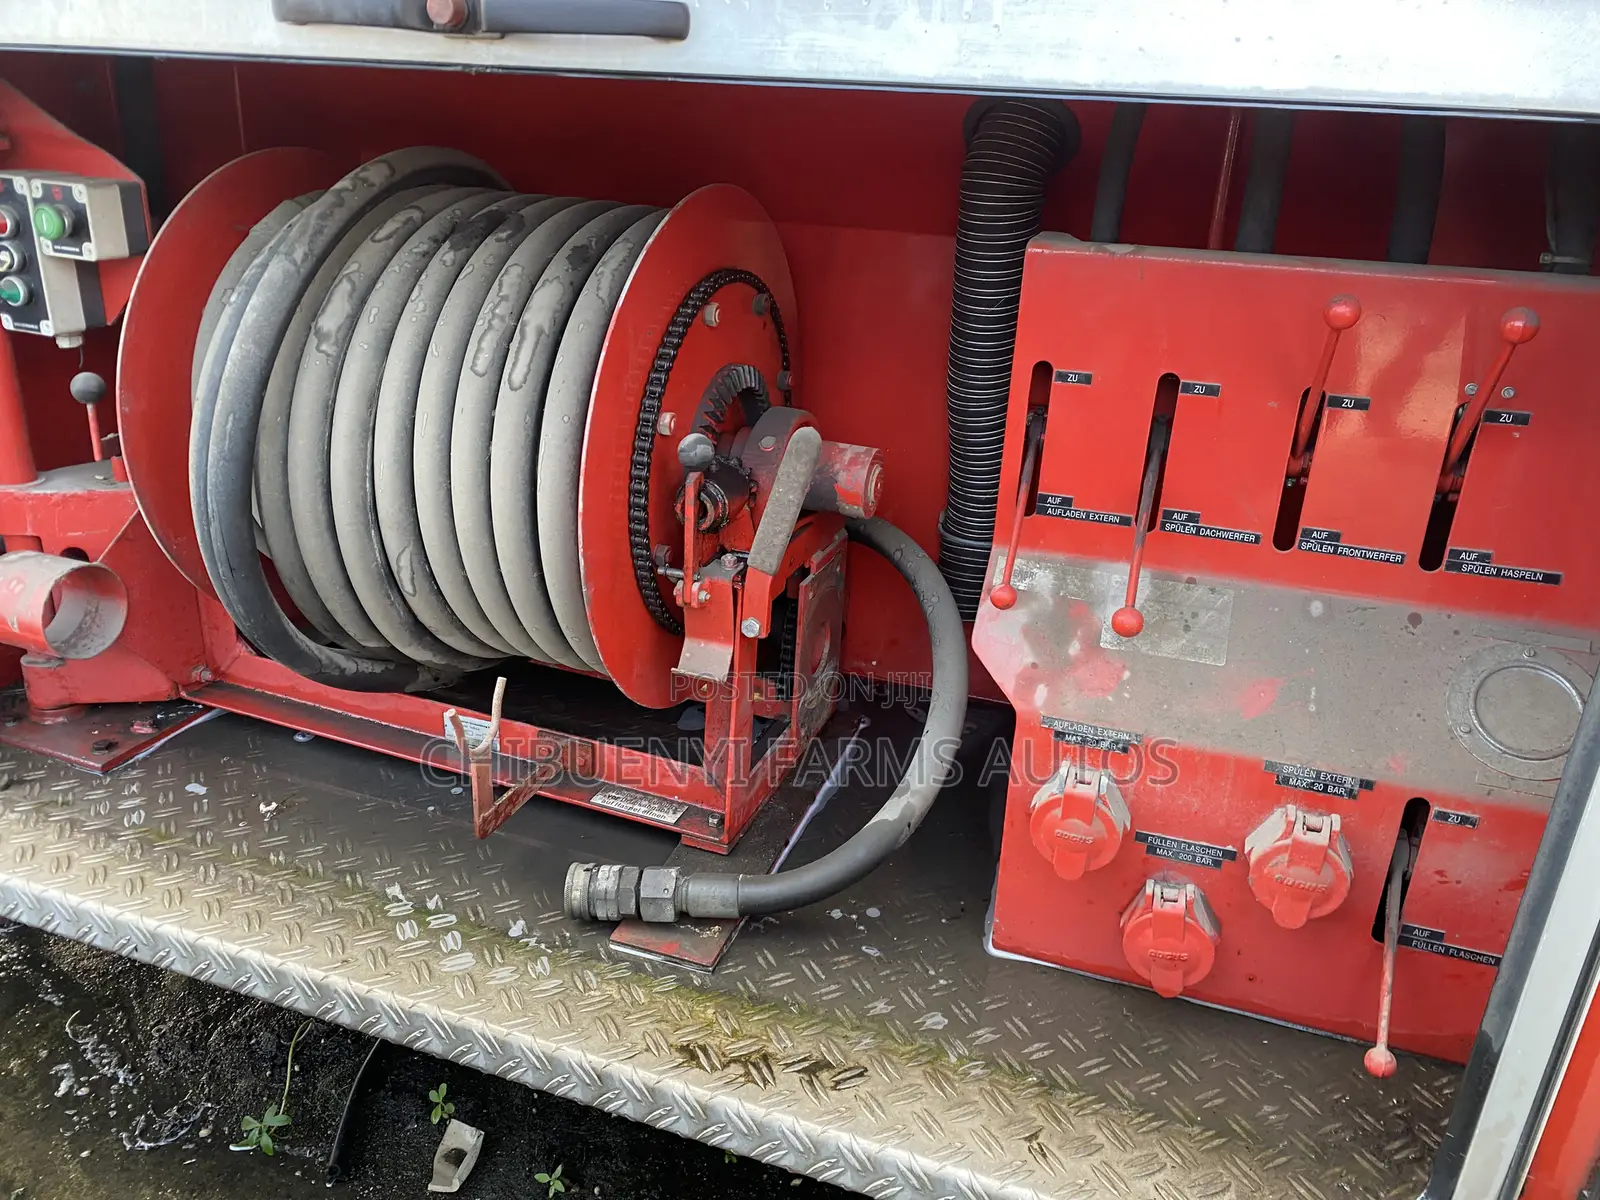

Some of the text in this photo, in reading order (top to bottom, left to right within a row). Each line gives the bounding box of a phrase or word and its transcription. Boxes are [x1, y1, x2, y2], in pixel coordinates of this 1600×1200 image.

[1067, 374, 1079, 382] ZU
[1194, 385, 1206, 394] ZU
[1342, 399, 1355, 408] ZU
[1499, 413, 1513, 423] ZU
[1046, 496, 1062, 505] AUF
[1046, 507, 1120, 523] AUFLADEN EXTERN
[1172, 512, 1189, 521] AUF
[1164, 522, 1255, 543] SPÜLEN DACHWERFER
[1311, 531, 1328, 540] AUF
[1300, 541, 1402, 563] SPÜLEN FRONTWERFER
[1459, 551, 1479, 561] AUF
[1461, 561, 1543, 581] SPÜLEN HASPELN
[1053, 720, 1130, 740] AUFLADEN EXTERN
[1087, 737, 1097, 746] 20
[1320, 772, 1355, 785] EXTERN
[1313, 782, 1324, 791] 20
[1447, 814, 1461, 824] ZU
[1147, 835, 1223, 857] FÜLLEN FLASCHEN
[1178, 852, 1192, 861] 200
[1412, 928, 1431, 938] AUF
[1411, 939, 1496, 965] FÜLLEN FLASCHEN
